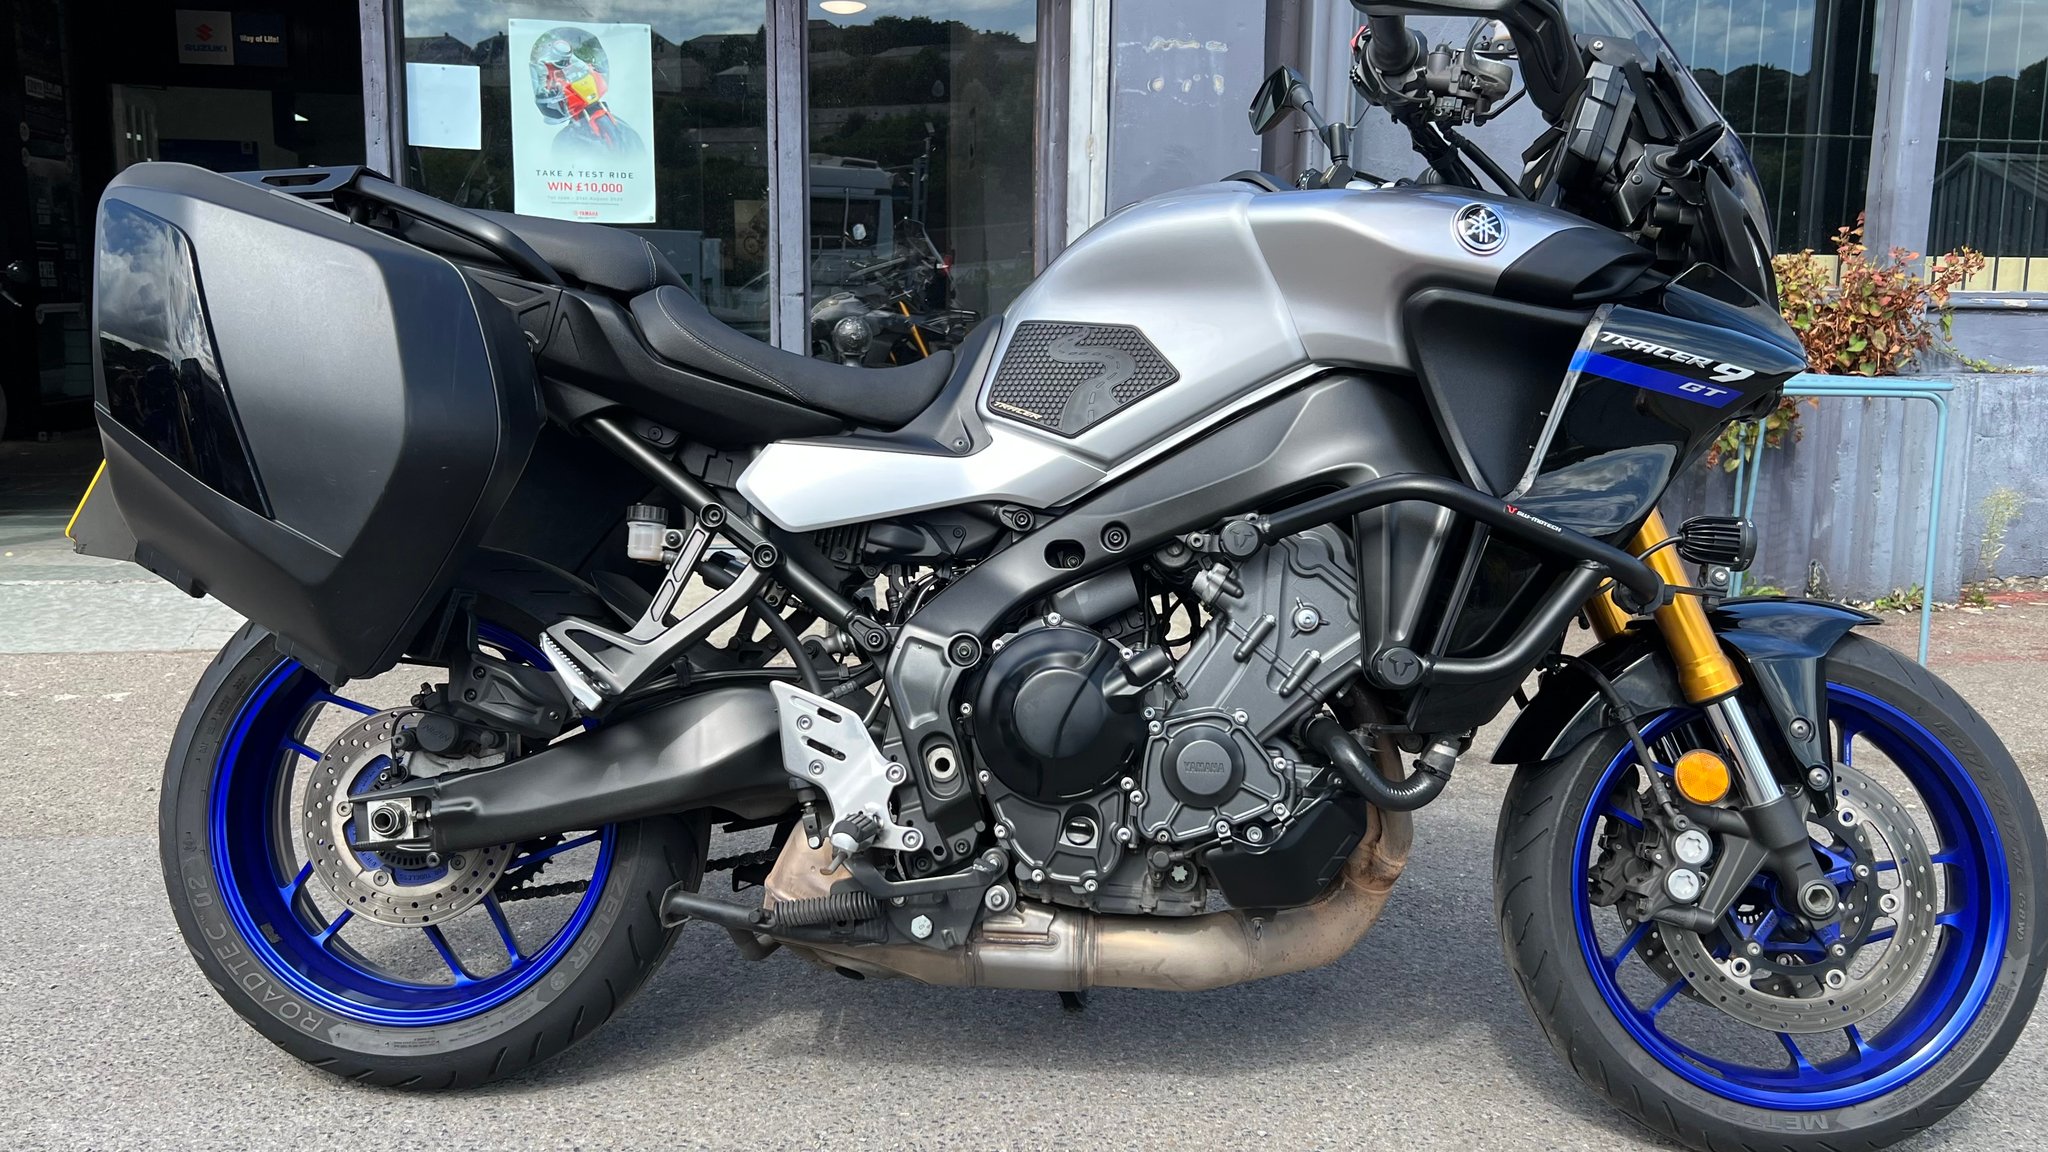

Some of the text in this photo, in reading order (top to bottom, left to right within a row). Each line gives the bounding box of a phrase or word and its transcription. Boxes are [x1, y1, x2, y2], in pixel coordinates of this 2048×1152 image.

[240, 35, 254, 43] Way
[263, 35, 279, 43] Life!
[184, 44, 227, 52] SUZUKI
[536, 169, 562, 177] TAKE
[547, 182, 623, 193] WIN £10,000
[1599, 331, 1756, 383] TRACER 9
[1677, 381, 1728, 398] GT
[993, 401, 1043, 420] TRACER
[1183, 761, 1225, 773] YAMAHA
[569, 840, 634, 970] ETZELER
[187, 876, 323, 1034] ROADTEC 02
